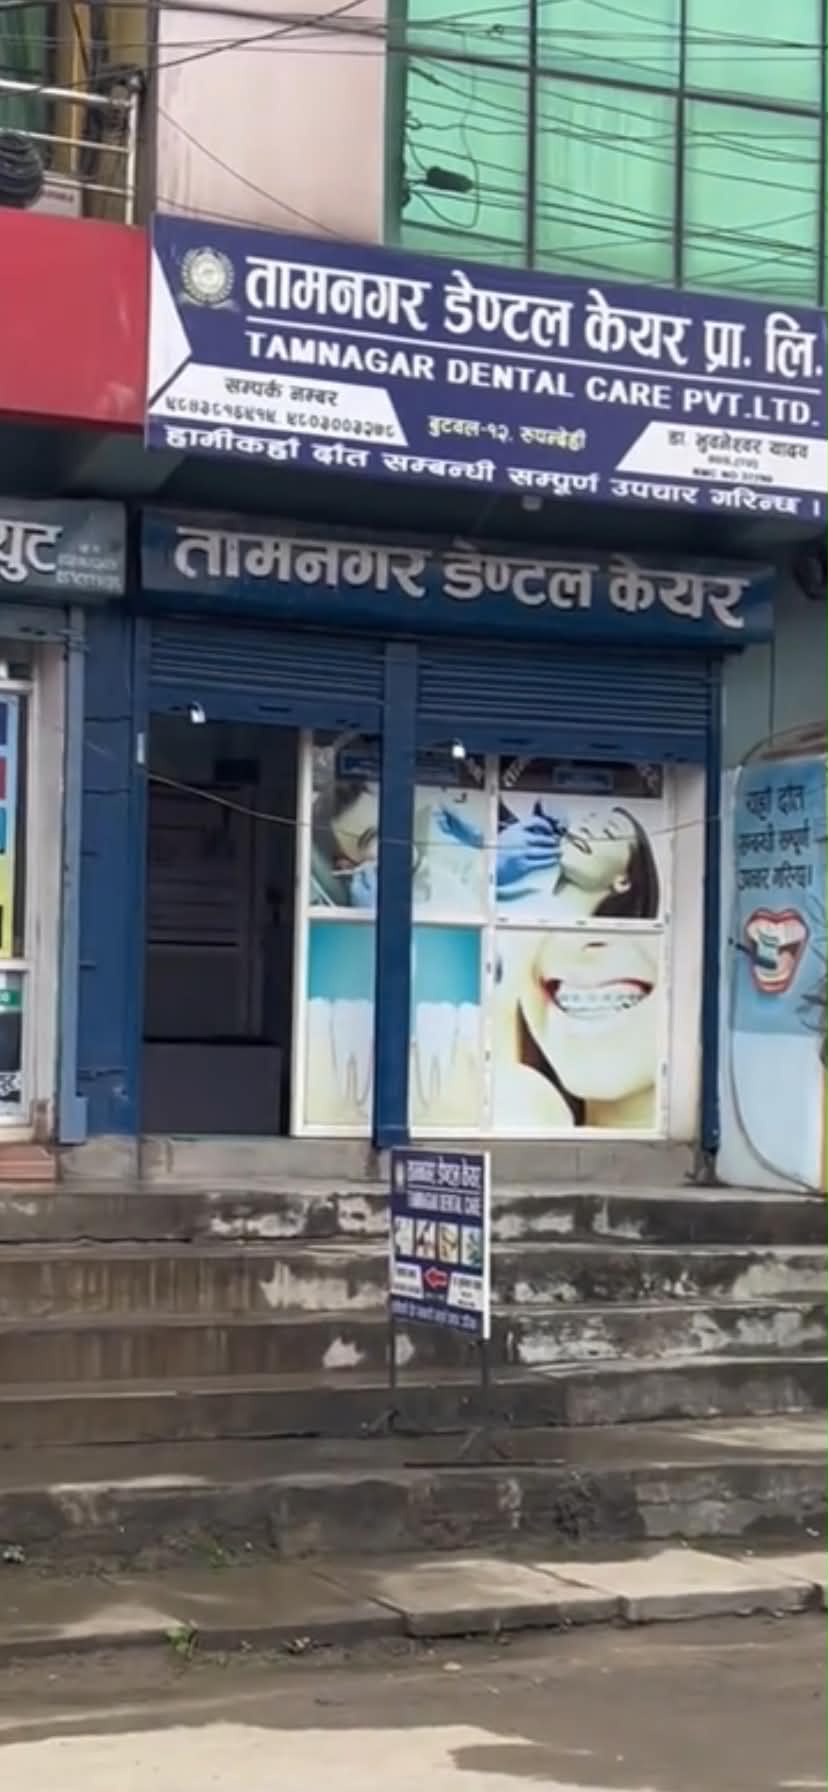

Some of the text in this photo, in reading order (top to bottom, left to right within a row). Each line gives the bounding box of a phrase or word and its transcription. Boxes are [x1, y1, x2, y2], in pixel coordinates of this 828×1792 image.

[245, 255, 433, 332] तामनगर
[444, 270, 575, 348] डेण्टल
[585, 288, 692, 366] केयर
[765, 311, 824, 378] लि.
[245, 331, 434, 381] TAMNAGAR
[447, 358, 575, 398] DENTAL
[585, 376, 672, 409] CARE
[609, 478, 699, 504] उपचार
[173, 526, 750, 629] तामनगर डेण्टल केयर
